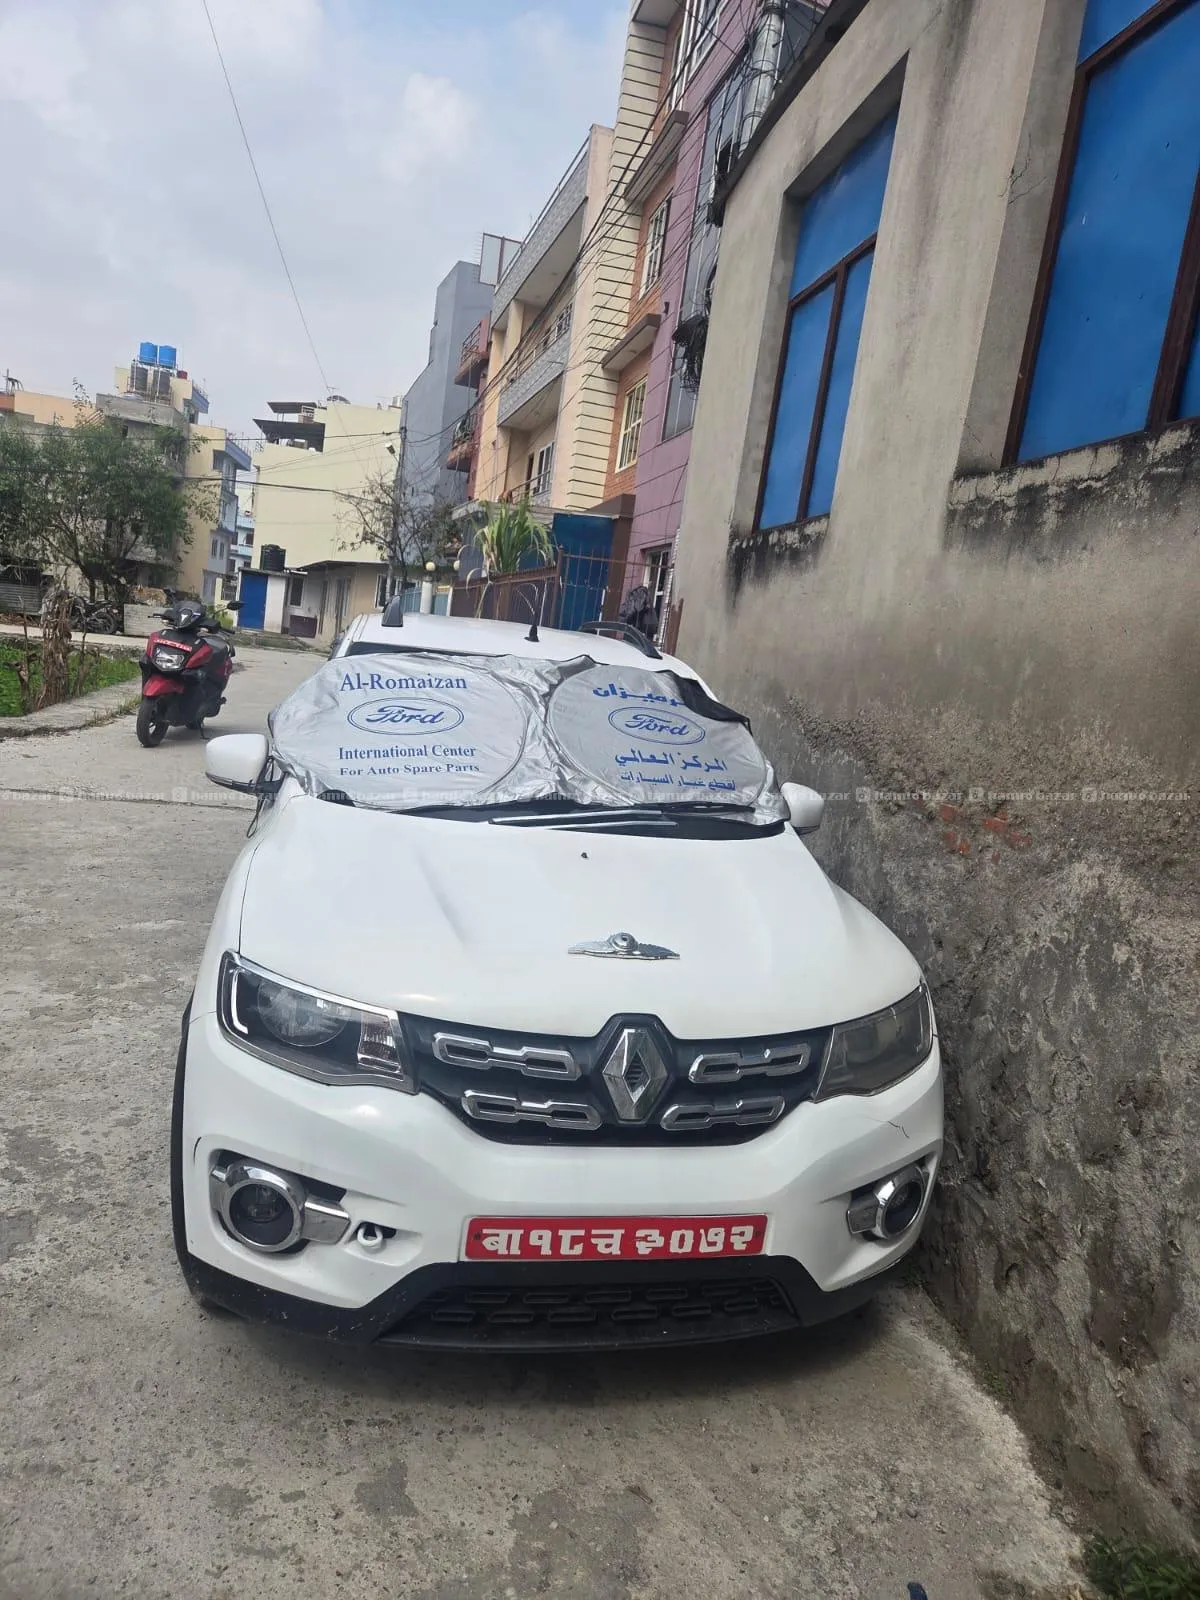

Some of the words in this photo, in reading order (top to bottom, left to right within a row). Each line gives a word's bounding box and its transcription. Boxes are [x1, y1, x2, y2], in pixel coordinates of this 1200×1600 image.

[340, 673, 467, 691] Al-Romaizan
[366, 705, 444, 724] Ford
[625, 713, 690, 736] Ford
[339, 745, 428, 760] International
[431, 745, 477, 758] Center
[615, 748, 675, 767] العالمي
[678, 752, 728, 772] المركز
[340, 767, 364, 776] For
[367, 766, 400, 776] Auto
[403, 764, 442, 775] Spare
[446, 763, 480, 773] Parts
